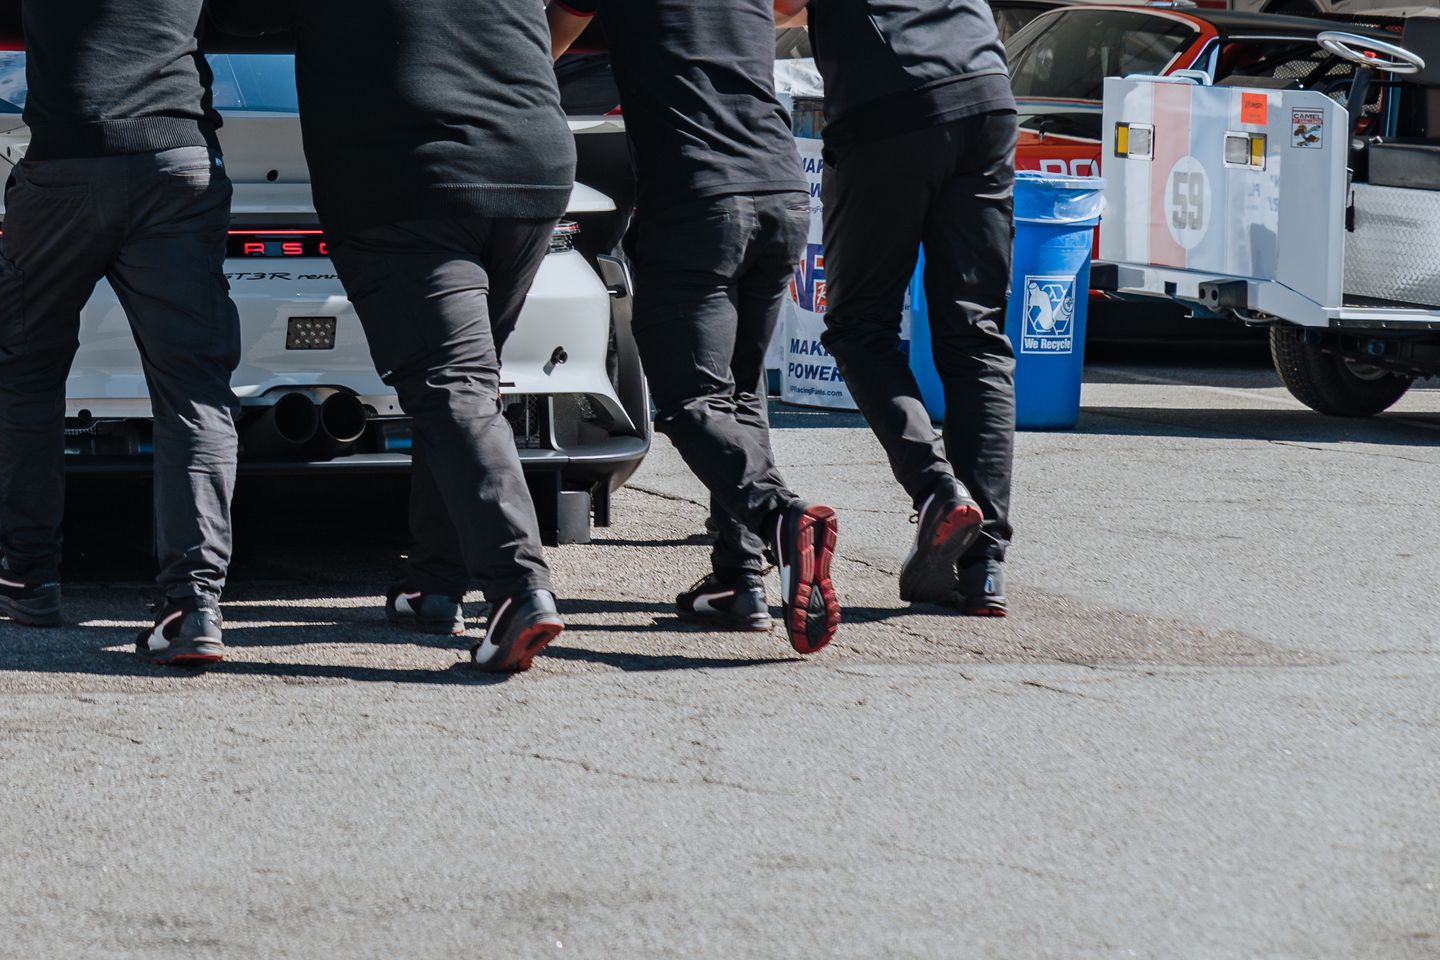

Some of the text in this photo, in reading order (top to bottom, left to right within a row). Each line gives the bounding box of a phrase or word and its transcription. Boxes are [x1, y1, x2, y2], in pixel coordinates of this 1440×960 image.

[1172, 171, 1204, 230] 59
[1024, 338, 1072, 351] We Recycle
[788, 362, 845, 382] POWER
